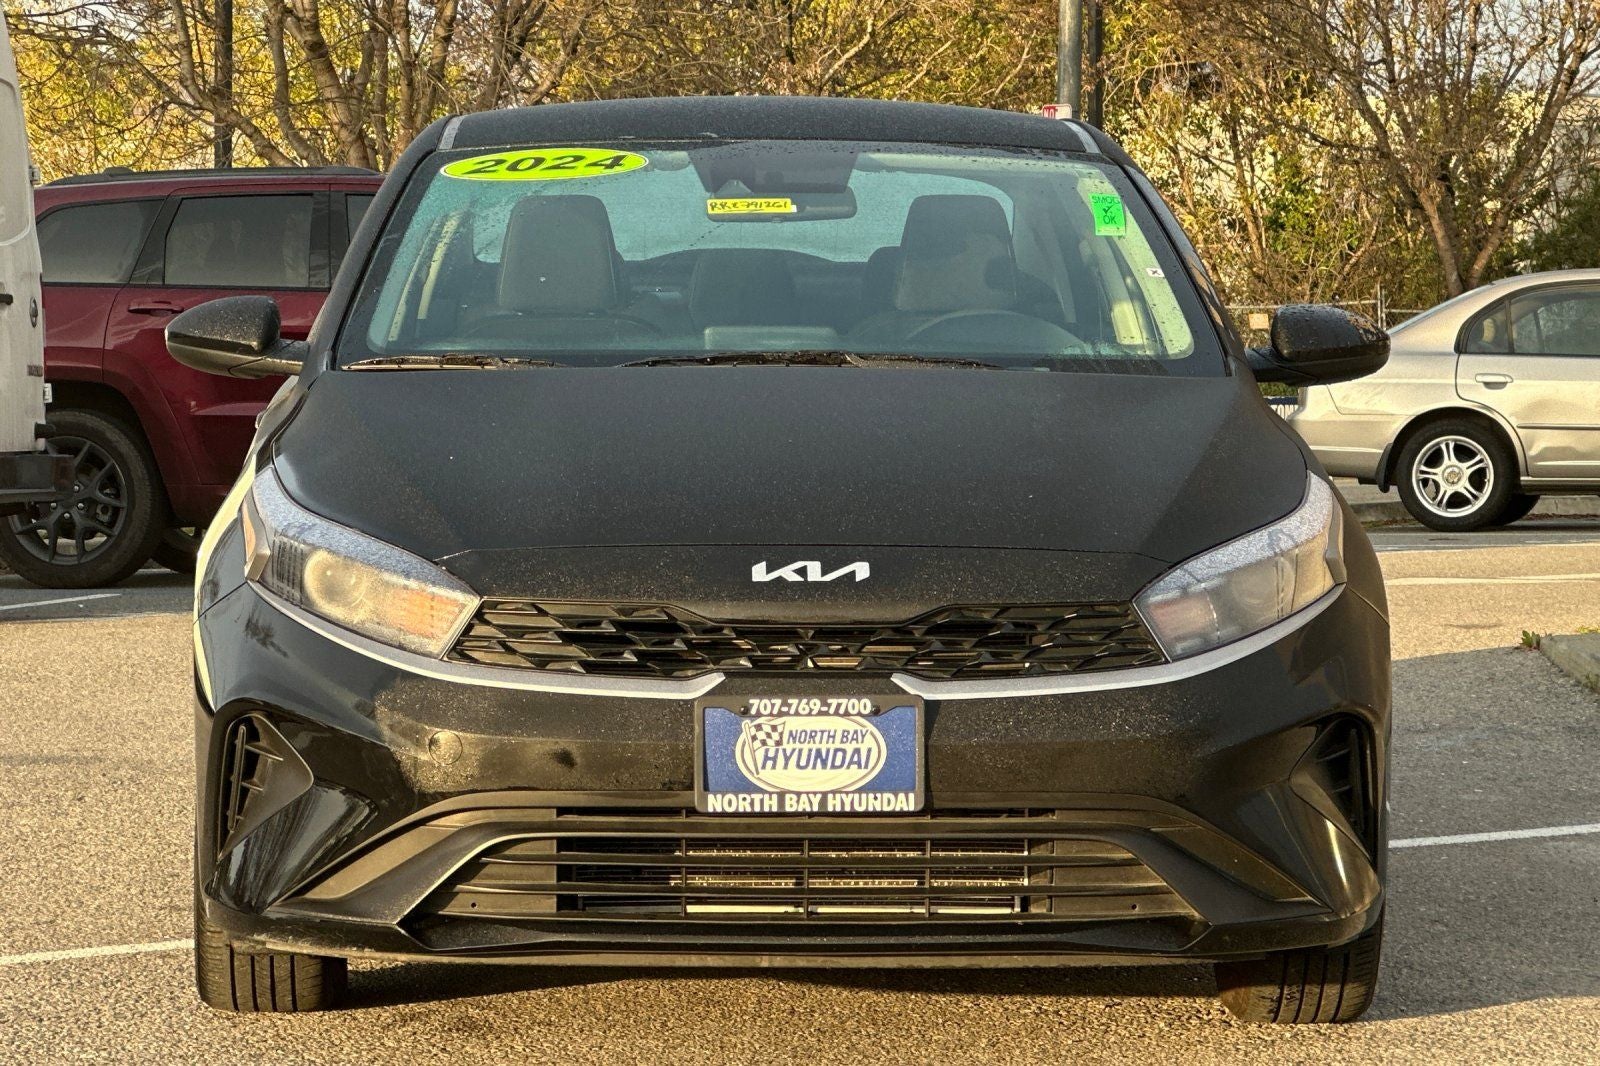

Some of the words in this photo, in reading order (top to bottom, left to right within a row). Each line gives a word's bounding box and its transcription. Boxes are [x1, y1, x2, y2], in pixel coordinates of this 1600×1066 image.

[462, 154, 628, 175] 2024
[1092, 196, 1120, 204] SMOG
[1103, 215, 1117, 224] OK
[752, 561, 870, 582] KIA
[749, 699, 872, 715] 707-769-7700
[787, 729, 836, 745] NORTH
[840, 729, 869, 744] BAY
[760, 747, 872, 770] HYUNDAI
[707, 794, 778, 812] NORTH
[785, 794, 822, 811] BAY
[827, 793, 915, 811] HYUNDAI
